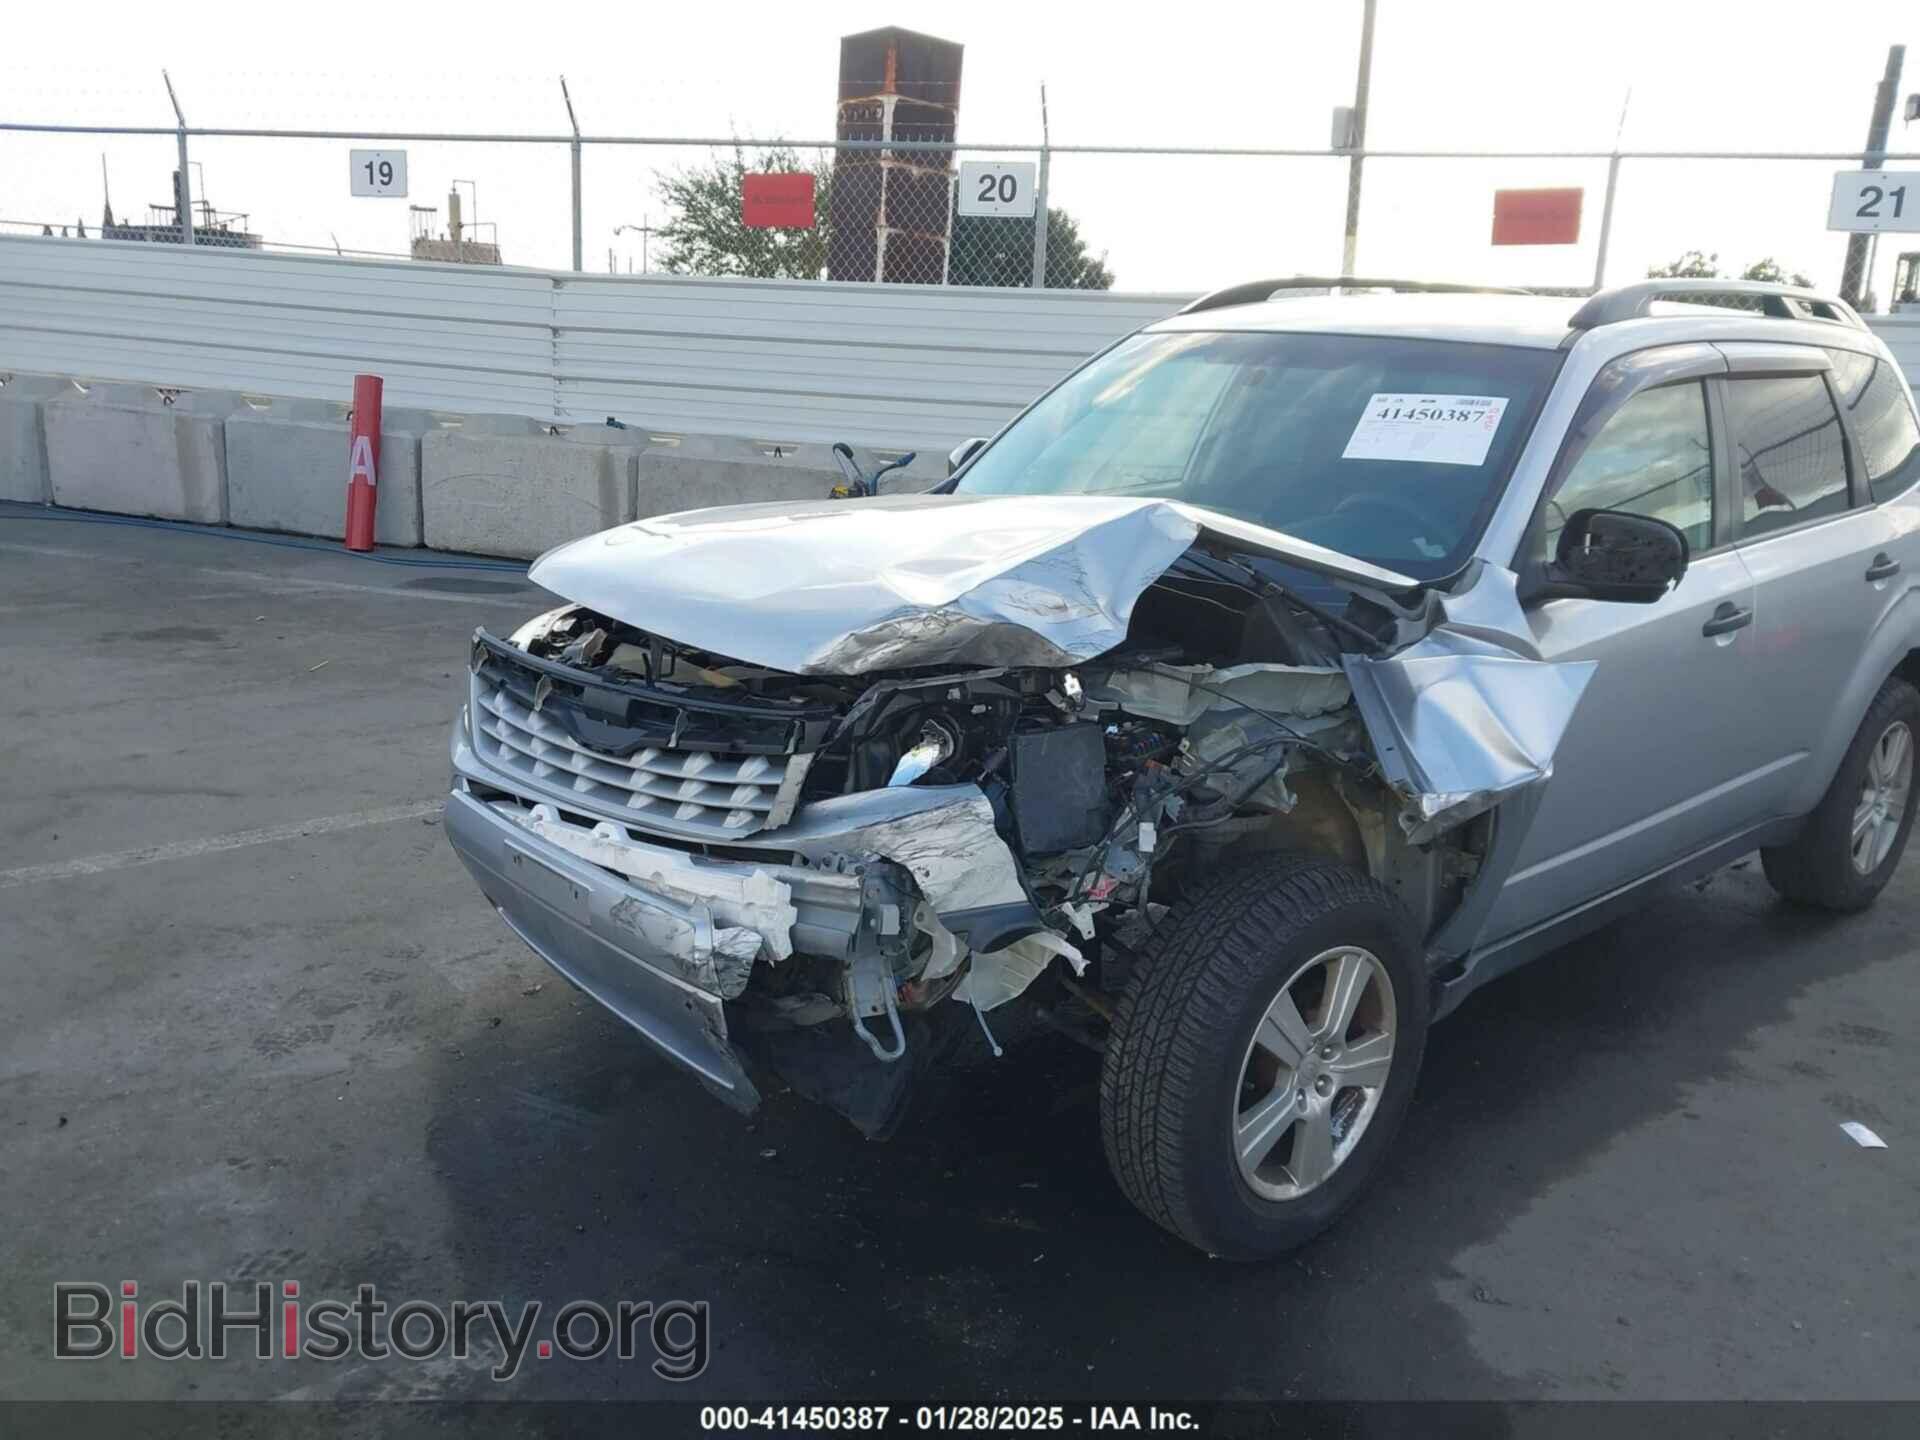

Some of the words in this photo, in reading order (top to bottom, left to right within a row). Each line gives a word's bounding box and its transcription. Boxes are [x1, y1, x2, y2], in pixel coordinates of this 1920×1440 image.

[364, 160, 393, 186] 19
[977, 173, 1017, 203] 20
[1855, 185, 1906, 218] 21
[1376, 407, 1485, 423] 41450387
[350, 435, 376, 486] A
